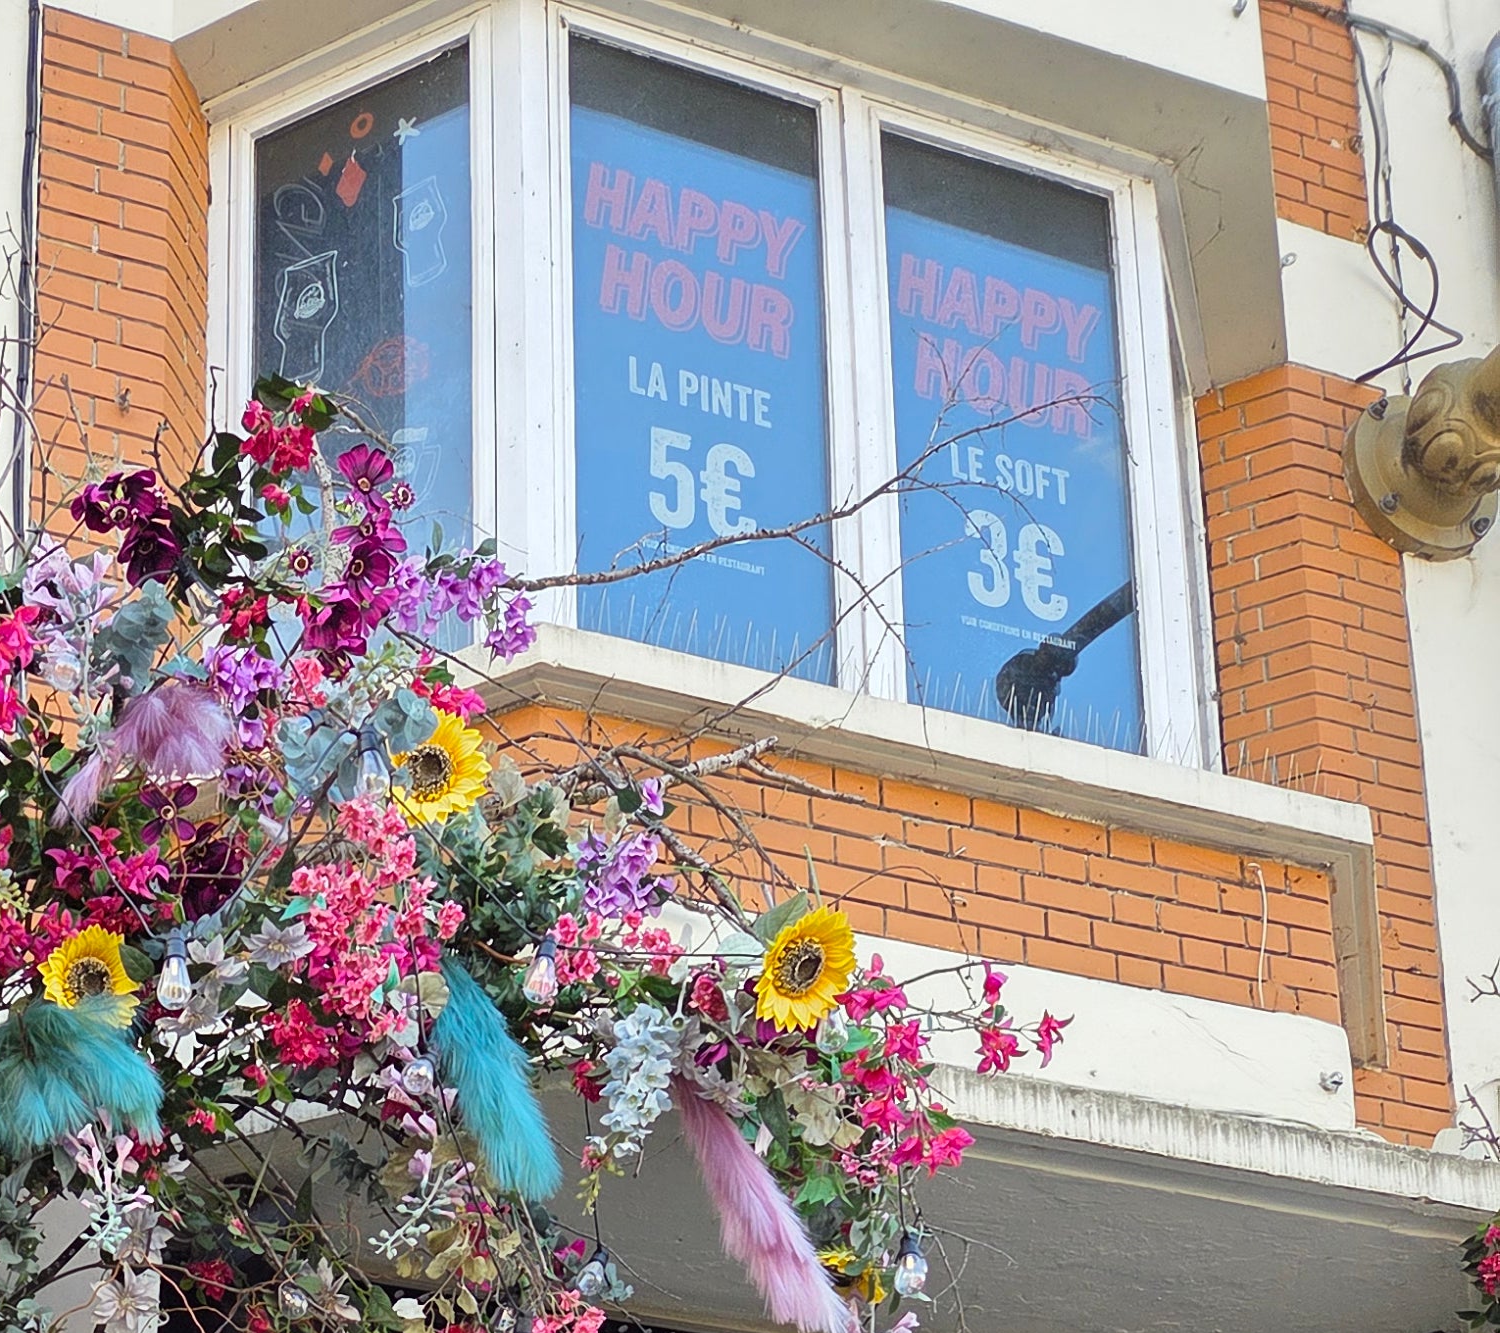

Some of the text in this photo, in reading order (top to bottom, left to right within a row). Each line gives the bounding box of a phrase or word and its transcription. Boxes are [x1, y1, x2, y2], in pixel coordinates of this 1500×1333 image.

[584, 161, 806, 280] HAPPY
[600, 243, 795, 360] HOUR
[897, 253, 1101, 364] HAPPY
[628, 355, 772, 428] LA PINTE
[914, 332, 1095, 440] HOUR
[649, 426, 758, 544] 5€
[950, 441, 1070, 505] LE SOFT
[965, 509, 1069, 622] 3€
